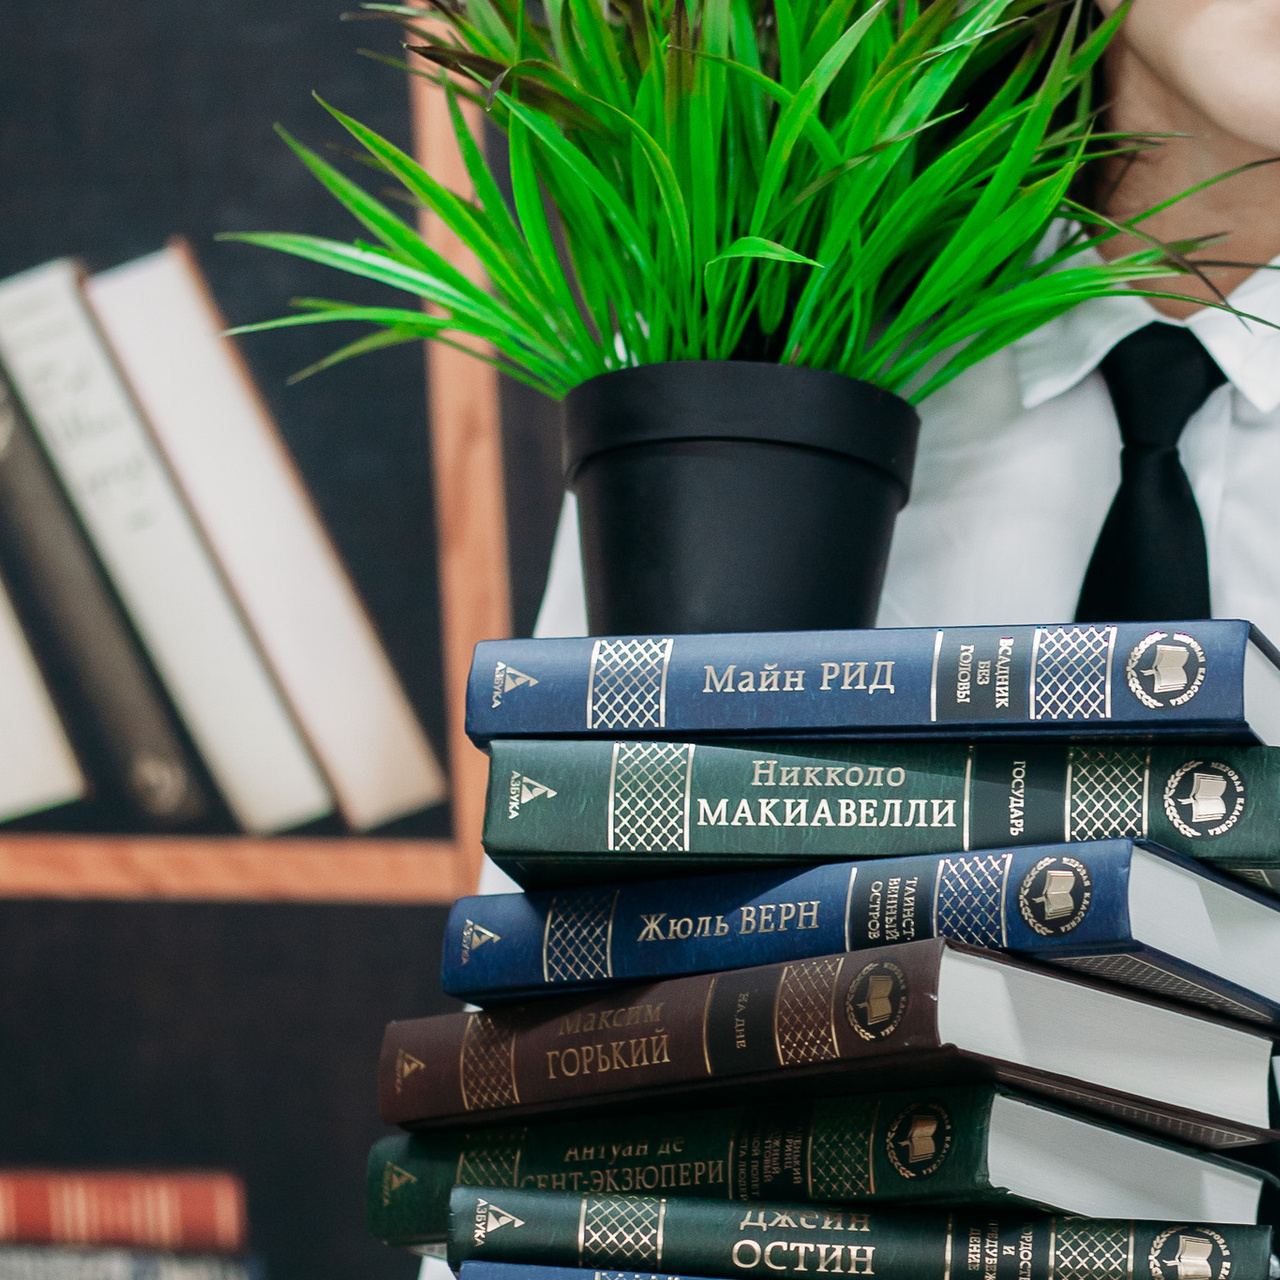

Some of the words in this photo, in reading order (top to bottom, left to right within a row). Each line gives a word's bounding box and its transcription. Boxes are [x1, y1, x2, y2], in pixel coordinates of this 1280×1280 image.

[491, 661, 507, 709] АЗБУКА
[702, 664, 805, 694] Майн
[819, 660, 897, 695] РИД
[956, 644, 975, 705] ГОЛОВЫ
[977, 660, 991, 686] БЕЗ
[995, 636, 1014, 709] ВСАДНИК
[750, 759, 907, 788] Никколо
[508, 770, 522, 821] АЗБУКА
[697, 798, 958, 829] МАКИАВЕЛЛИ
[1008, 760, 1027, 837] ГОСУДАРЬ
[637, 913, 730, 942] Жюль
[739, 900, 821, 936] ВЕРН
[868, 881, 883, 940] ОСТРОВ
[885, 877, 901, 941] ВЕННЫЙ
[558, 1002, 664, 1037] Максим
[734, 1017, 747, 1050] ДНЕ
[546, 1027, 671, 1079] ГОРЬКИЙ
[563, 1136, 649, 1166] Антуан
[656, 1135, 686, 1157] де
[473, 1197, 489, 1247] АЗБУКА
[739, 1204, 871, 1233] Джейн
[731, 1239, 877, 1275] ОСТИН
[967, 1227, 982, 1271] ДЕНИЕ
[1002, 1245, 1016, 1256] И
